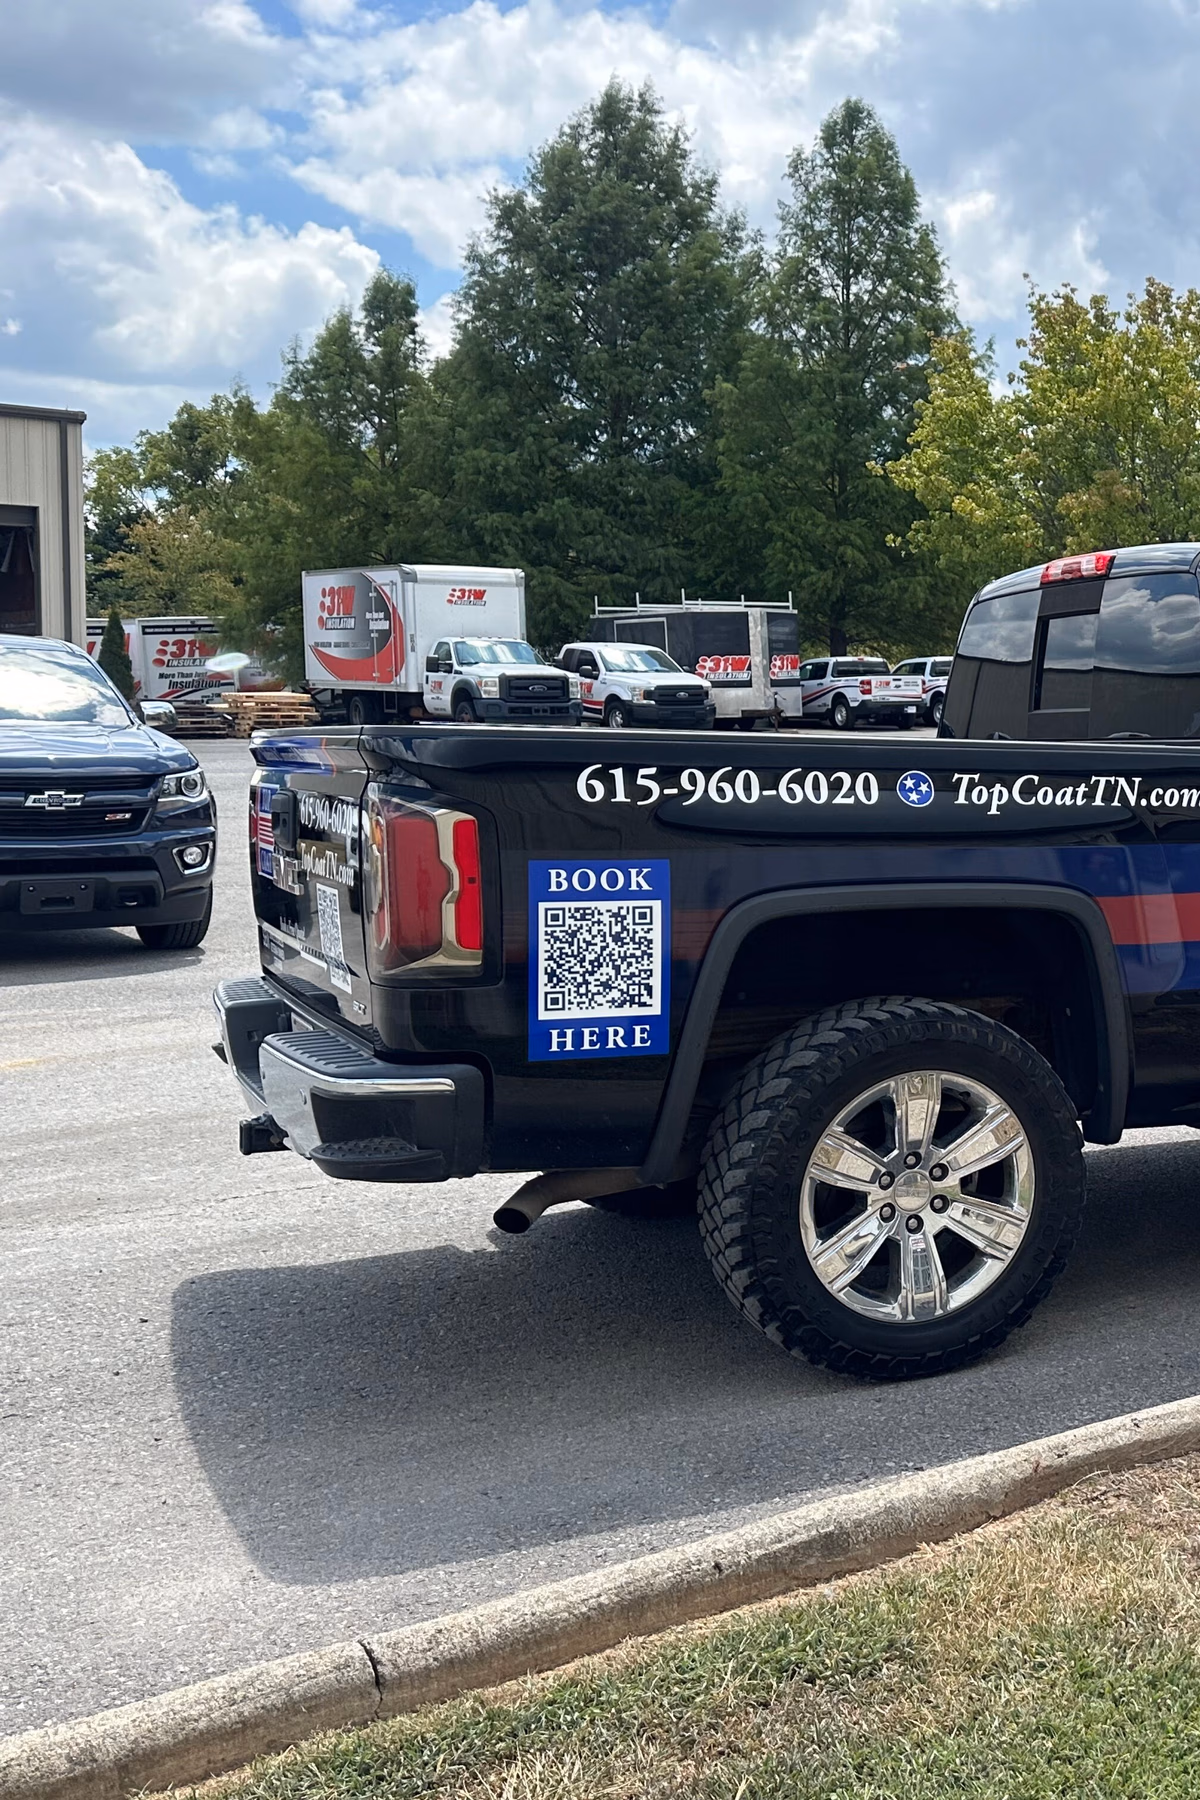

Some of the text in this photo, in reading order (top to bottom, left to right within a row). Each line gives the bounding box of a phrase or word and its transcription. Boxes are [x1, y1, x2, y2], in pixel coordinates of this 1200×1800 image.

[326, 617, 355, 629] INSULATION
[168, 678, 221, 690] Insulation
[576, 764, 879, 806] 615-960-6020
[300, 794, 353, 836] 615-960-6020
[300, 842, 354, 887] TopCoatTN.com
[548, 867, 653, 892] BOOK
[548, 1025, 652, 1052] HERE
